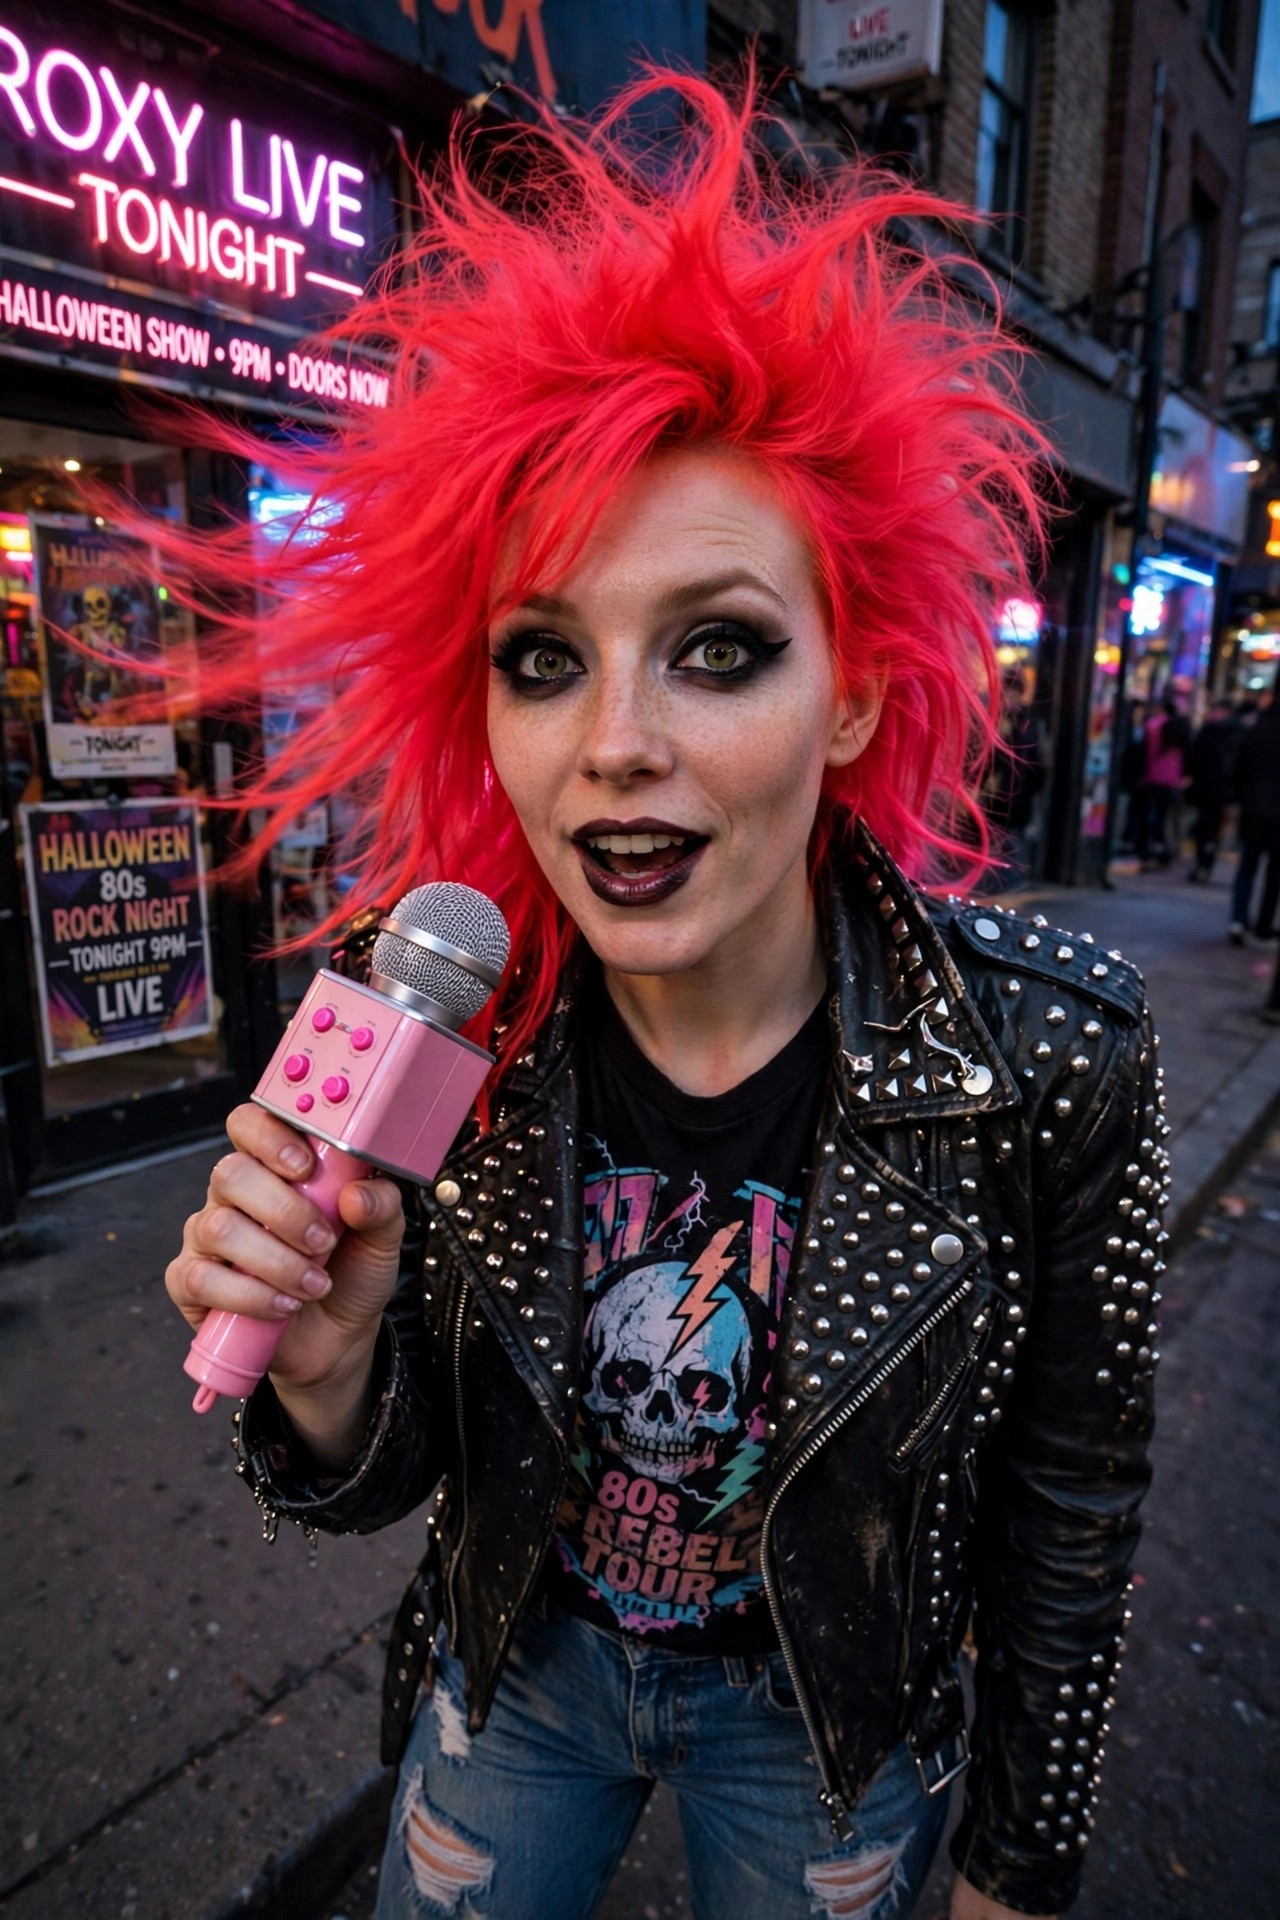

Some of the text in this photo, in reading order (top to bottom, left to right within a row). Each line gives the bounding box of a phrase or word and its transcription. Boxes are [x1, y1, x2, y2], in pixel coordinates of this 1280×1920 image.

[0, 24, 365, 248] ROXY LIVE
[79, 172, 305, 298] TONIGHT
[0, 279, 389, 408] HALLOWEEN SHOW 9PM DOORS NOW
[38, 825, 191, 873] HALLOWEEN
[53, 895, 190, 943] ROCK NIGHT
[69, 932, 186, 973] TONIGHT 9PM
[97, 975, 163, 1012] LIVE
[582, 1534, 716, 1605] TOUR
[583, 1502, 747, 1572] REBEL
